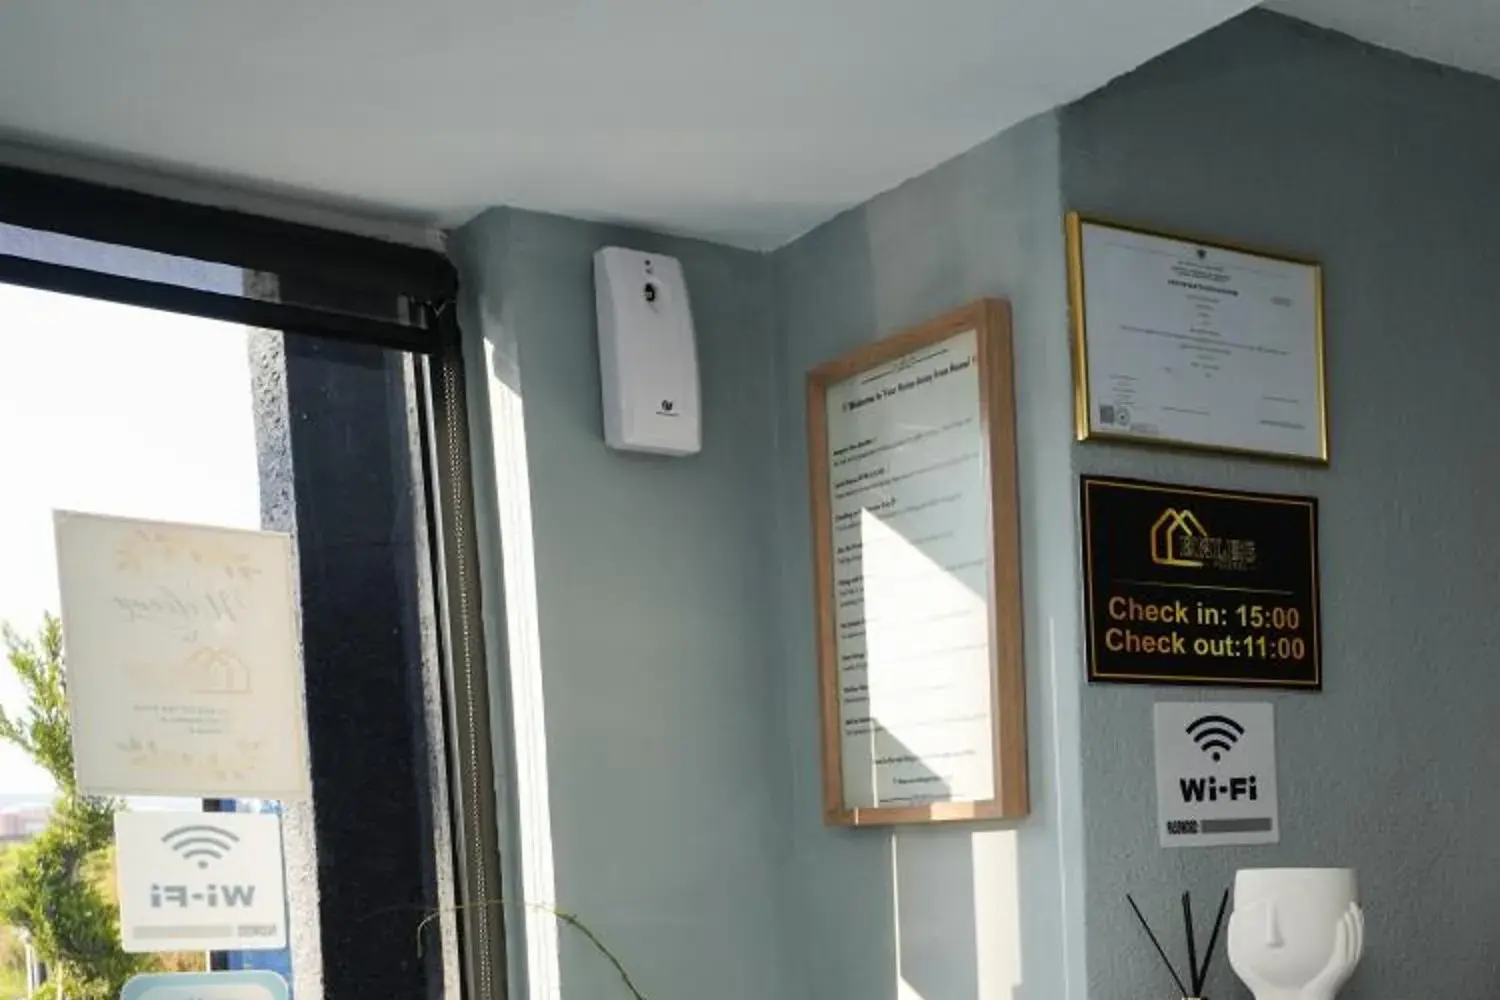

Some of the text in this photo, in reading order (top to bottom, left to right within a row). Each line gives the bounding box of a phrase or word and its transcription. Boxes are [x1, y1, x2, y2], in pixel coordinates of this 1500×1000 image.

[1108, 596, 1300, 630] Check in: 15:00
[1105, 628, 1186, 655] Check
[1179, 775, 1258, 803] Wi-Fi
